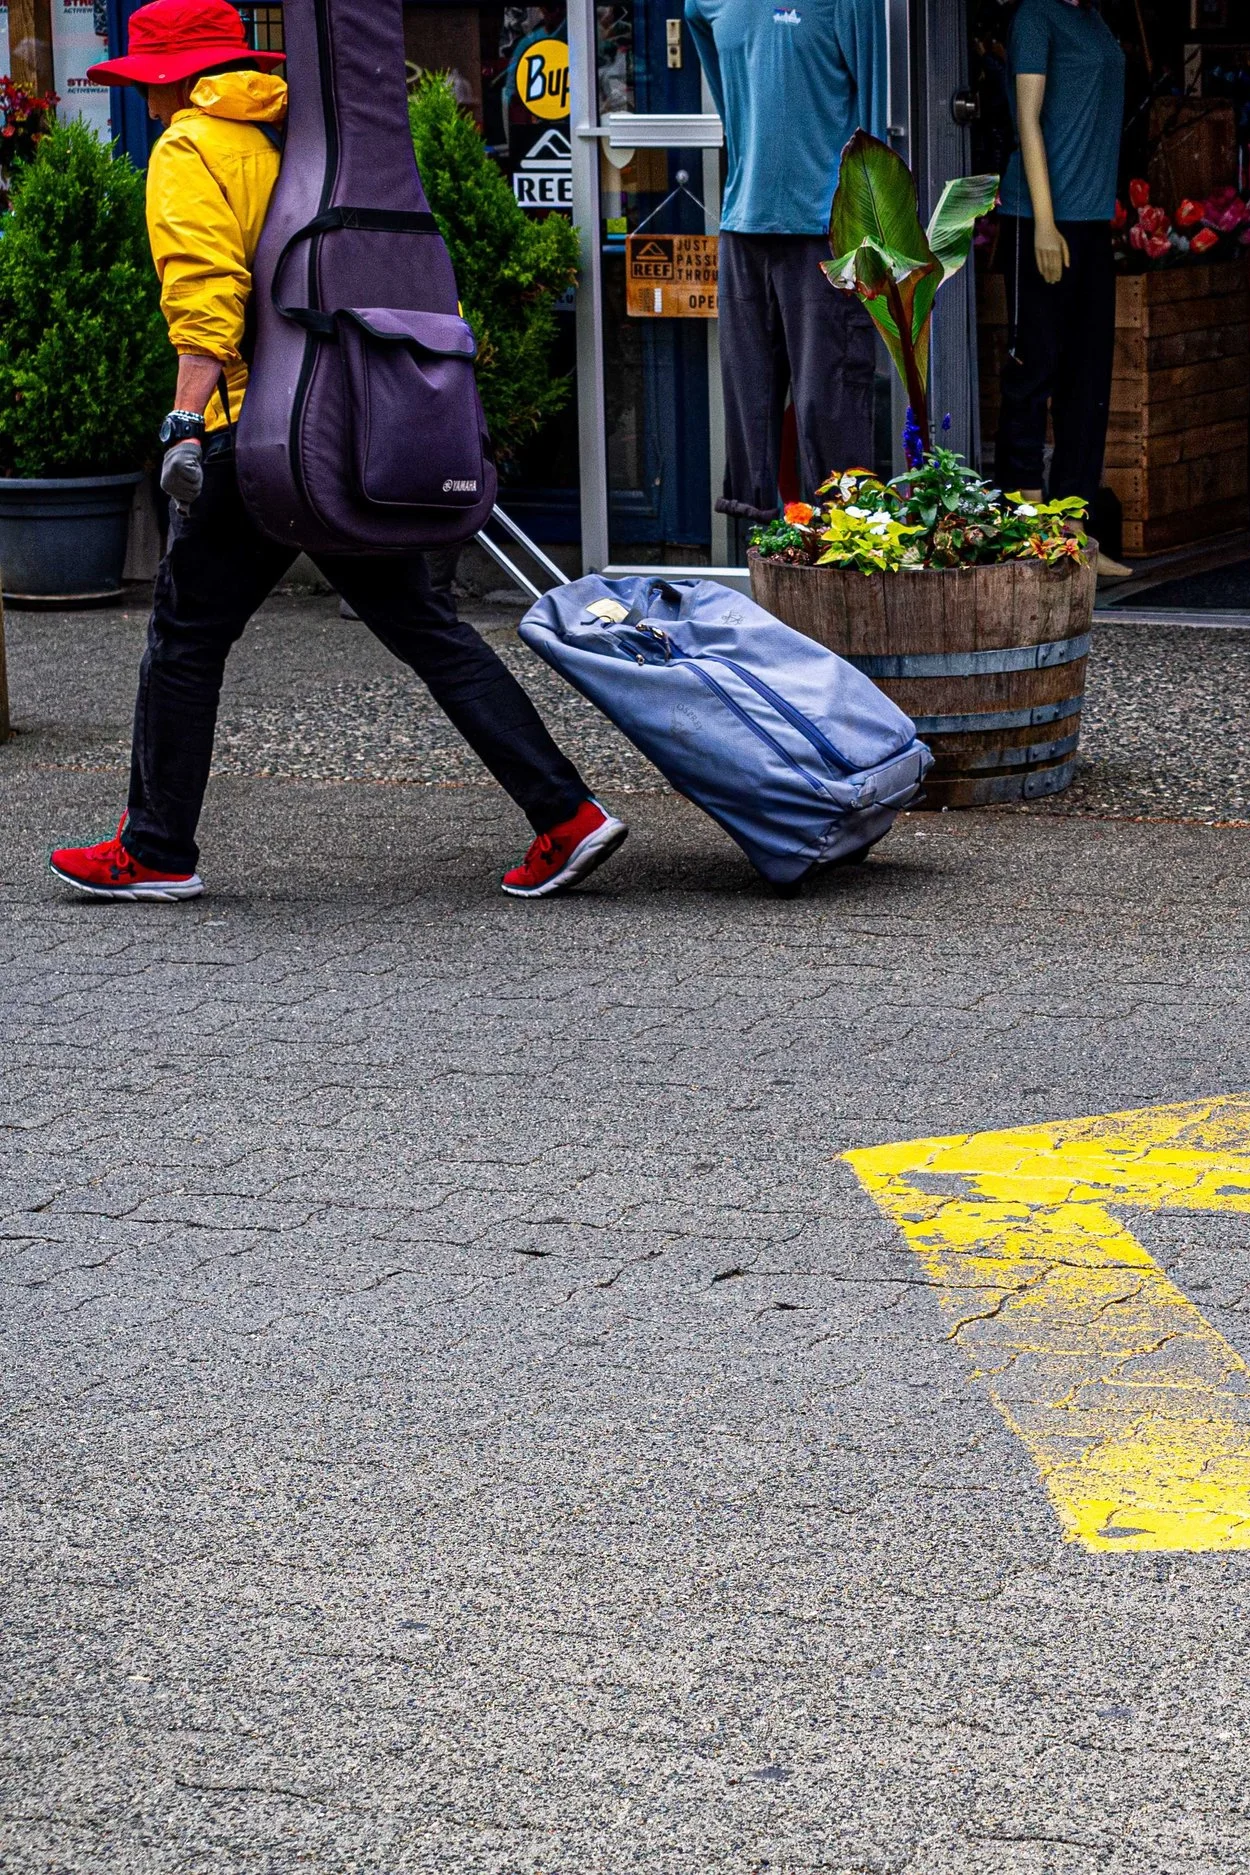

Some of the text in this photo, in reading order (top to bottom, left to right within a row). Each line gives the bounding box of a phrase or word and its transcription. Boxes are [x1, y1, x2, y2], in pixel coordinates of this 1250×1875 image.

[67, 78, 98, 87] STR
[517, 178, 573, 202] REE
[677, 240, 707, 251] JUST
[677, 255, 717, 266] PASSI
[634, 263, 671, 276] REEF
[677, 269, 719, 281] THROU
[689, 295, 718, 309] OPE
[453, 480, 477, 491] YAMAHA
[676, 703, 703, 731] OSPREY
